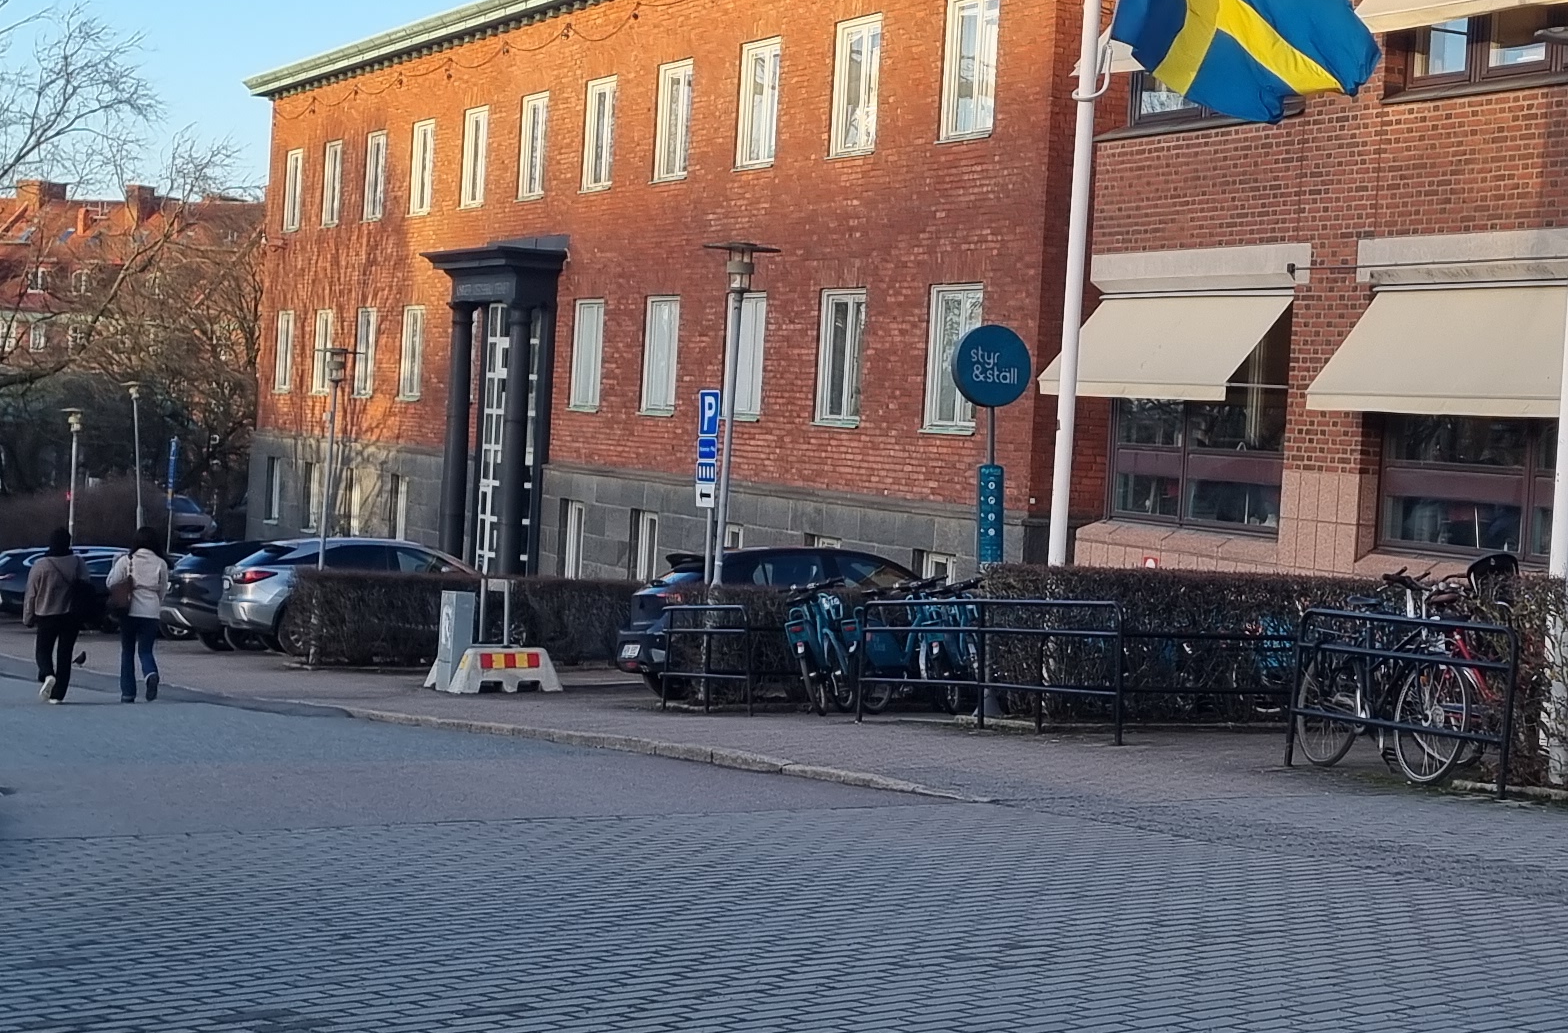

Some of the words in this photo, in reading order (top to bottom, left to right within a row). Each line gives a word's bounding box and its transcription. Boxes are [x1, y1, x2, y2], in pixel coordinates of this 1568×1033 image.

[970, 346, 1000, 367] styr
[972, 364, 1018, 385] &ställ
[704, 396, 716, 431] P
